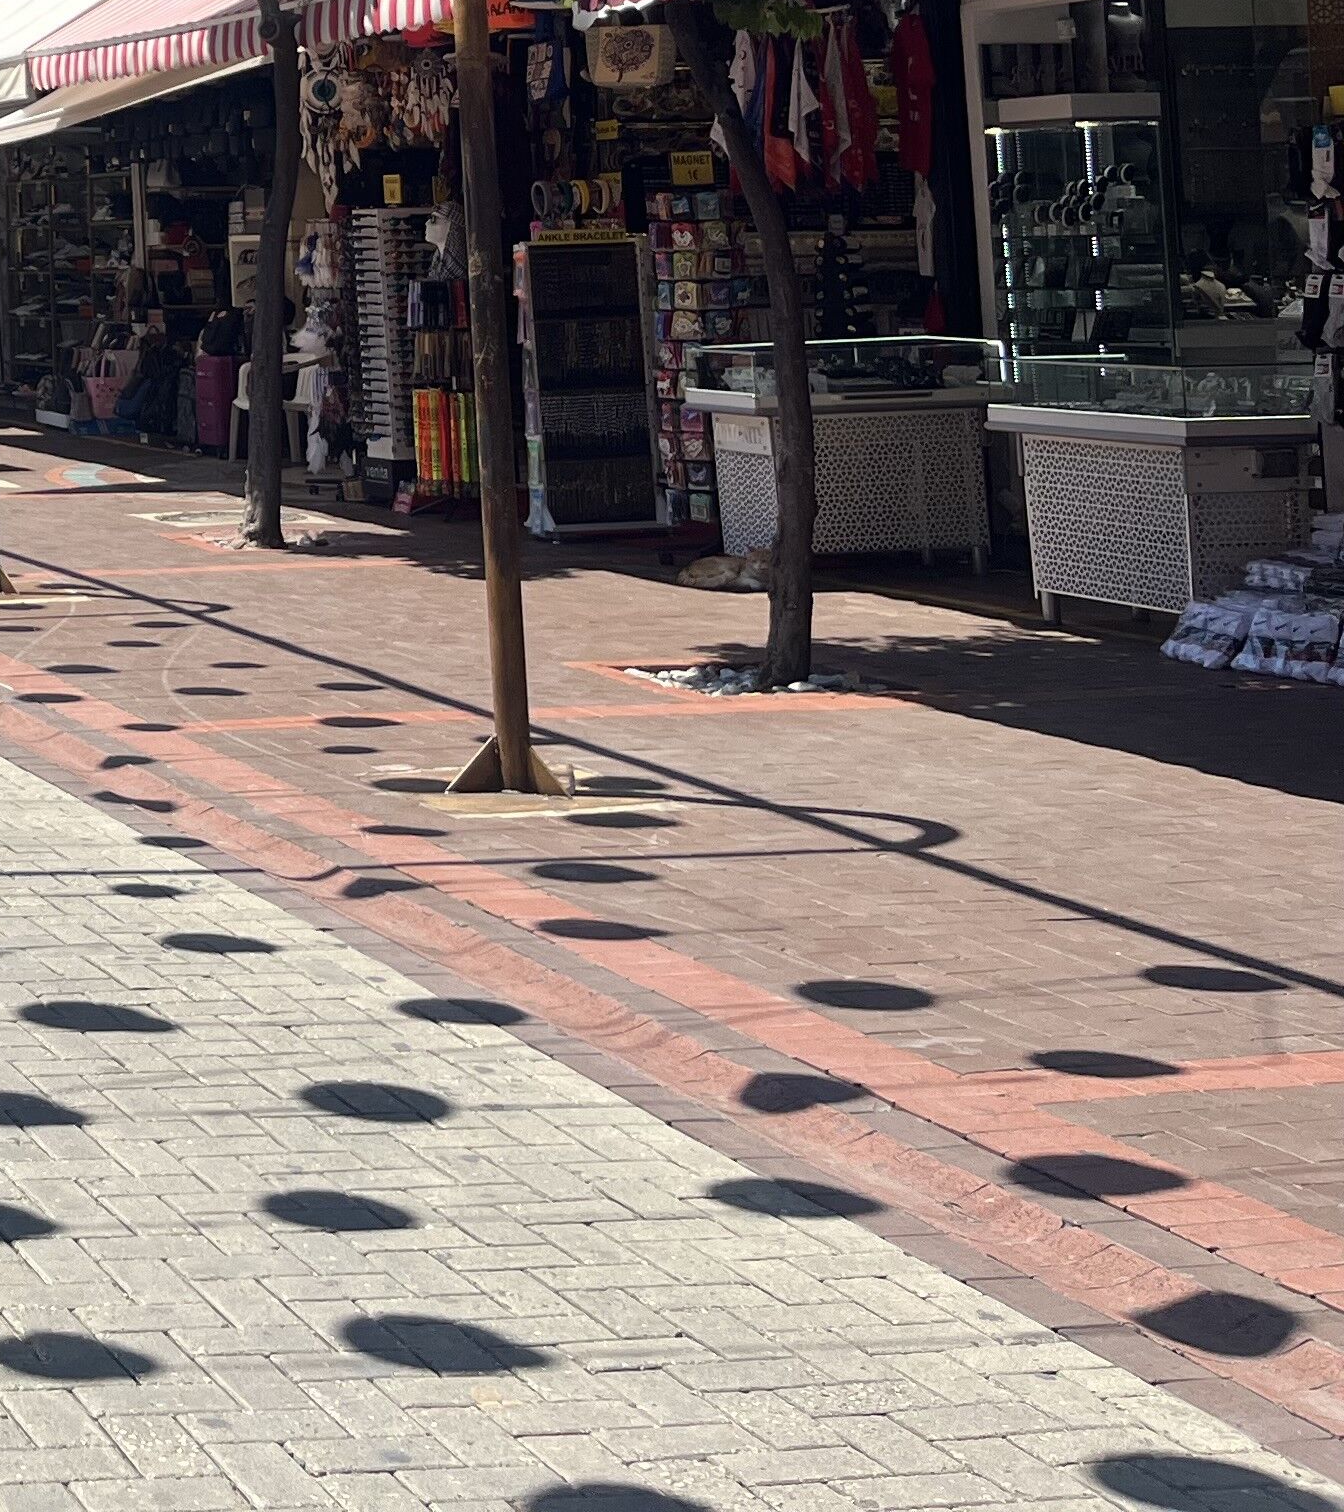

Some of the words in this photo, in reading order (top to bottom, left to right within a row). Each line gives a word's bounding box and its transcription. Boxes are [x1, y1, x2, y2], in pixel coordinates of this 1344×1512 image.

[672, 153, 711, 166] MAGNET
[537, 232, 569, 242] ANKLE
[572, 231, 626, 241] BRACELET
